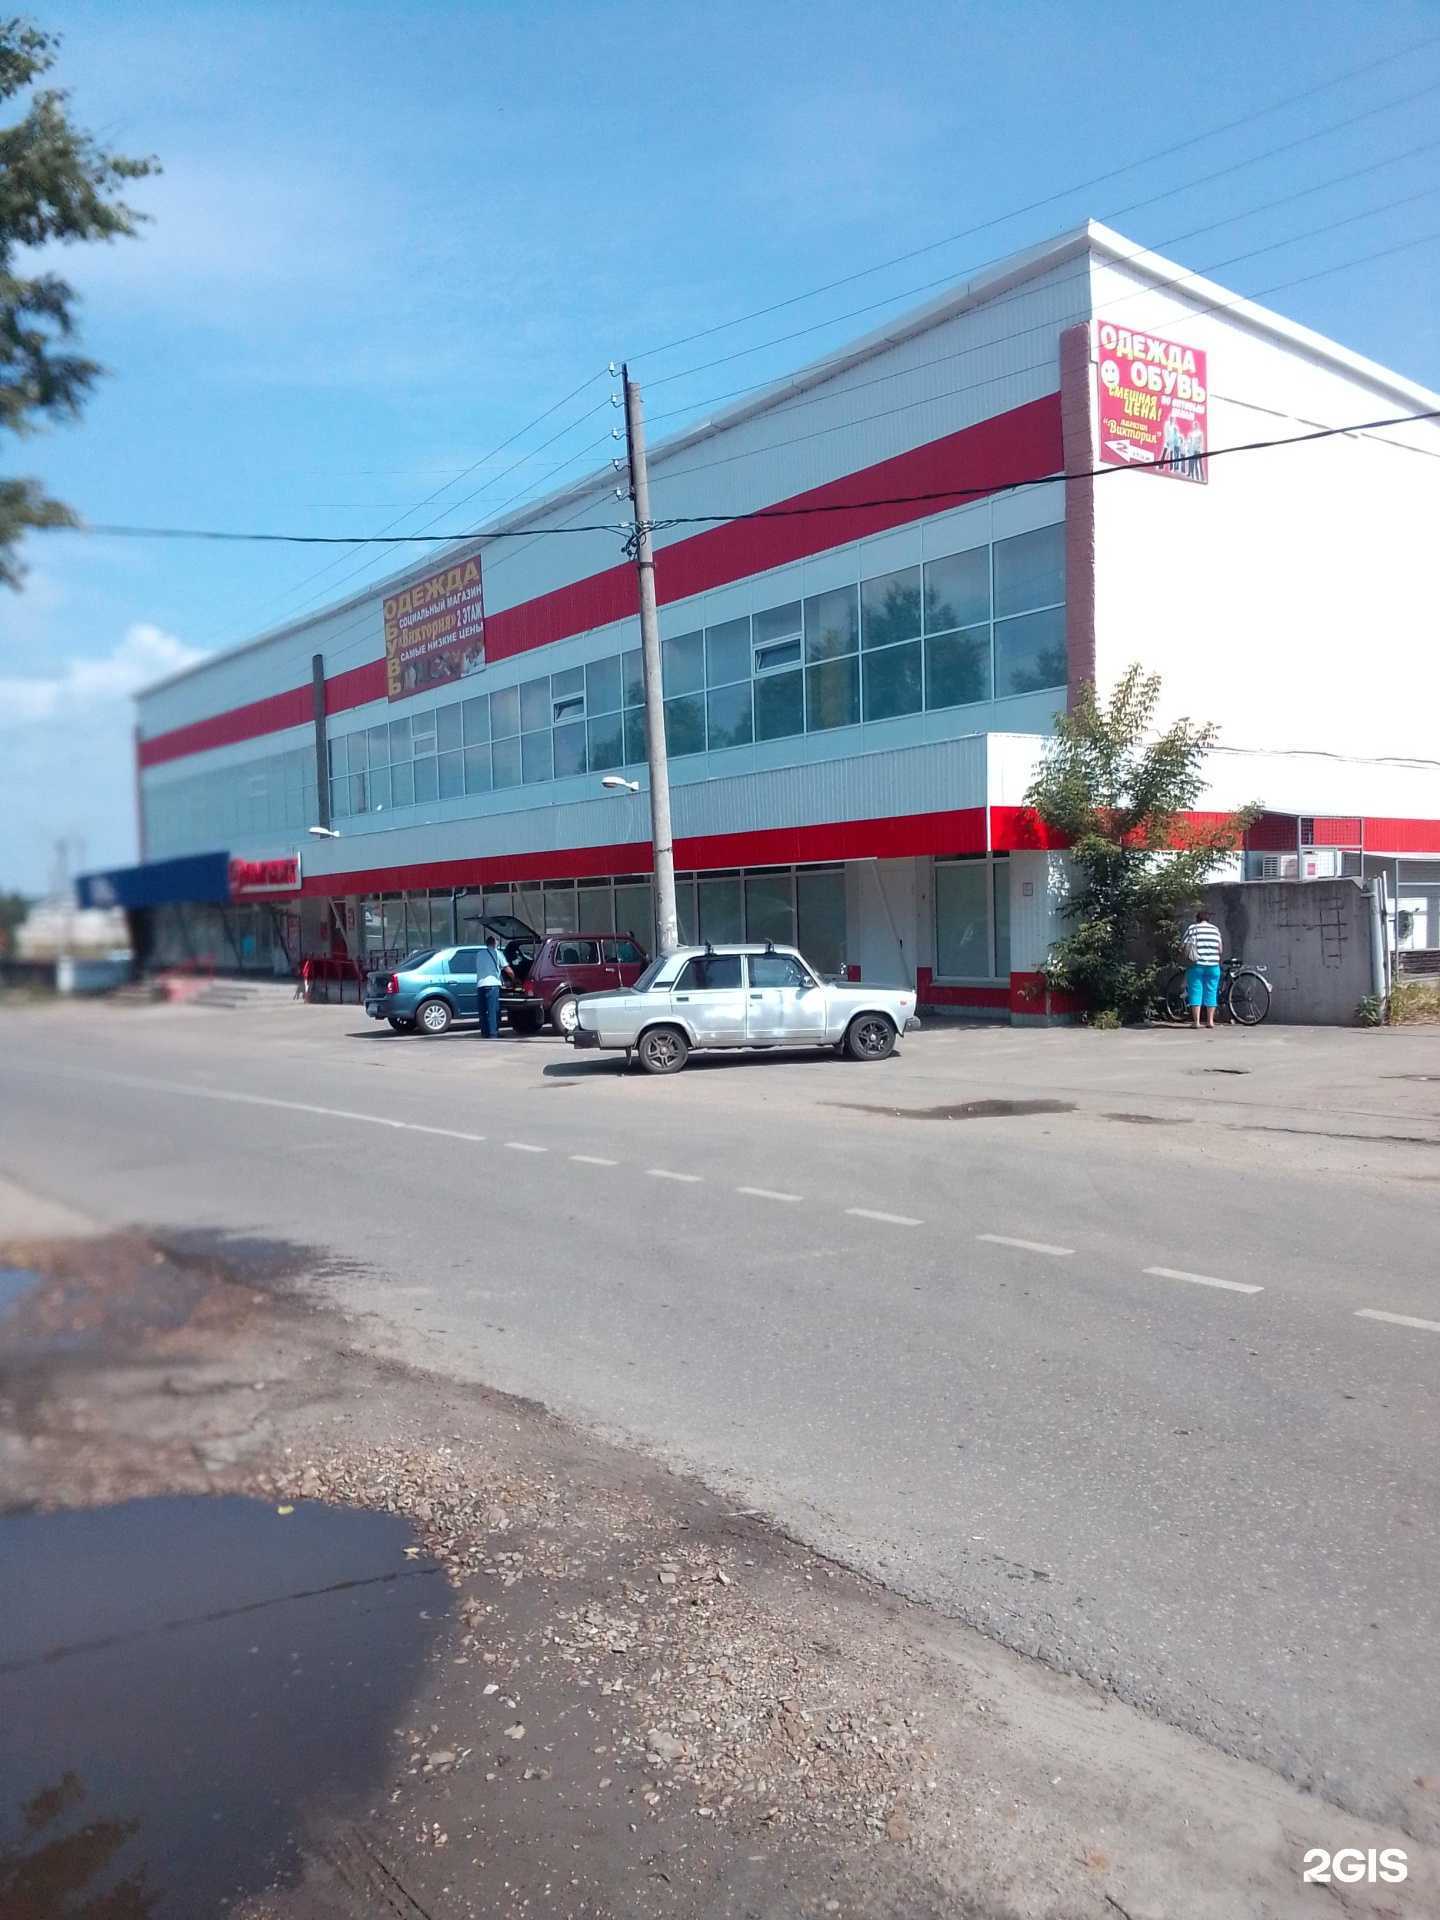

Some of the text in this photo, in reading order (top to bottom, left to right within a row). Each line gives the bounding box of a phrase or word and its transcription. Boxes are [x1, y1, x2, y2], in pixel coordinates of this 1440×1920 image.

[1100, 325, 1196, 373] ОДЕЖДА
[1131, 361, 1206, 402] ОБУВЬ
[384, 560, 480, 619] ОДЕЖДА
[399, 583, 482, 629] СОЦИАЛЬНЫЙ МАГАЗИН
[456, 609, 462, 627] 2
[462, 601, 483, 624] ЭТАЖ
[400, 621, 484, 662] САМЫЕ НИЗКИЕ ЦЕНЫ
